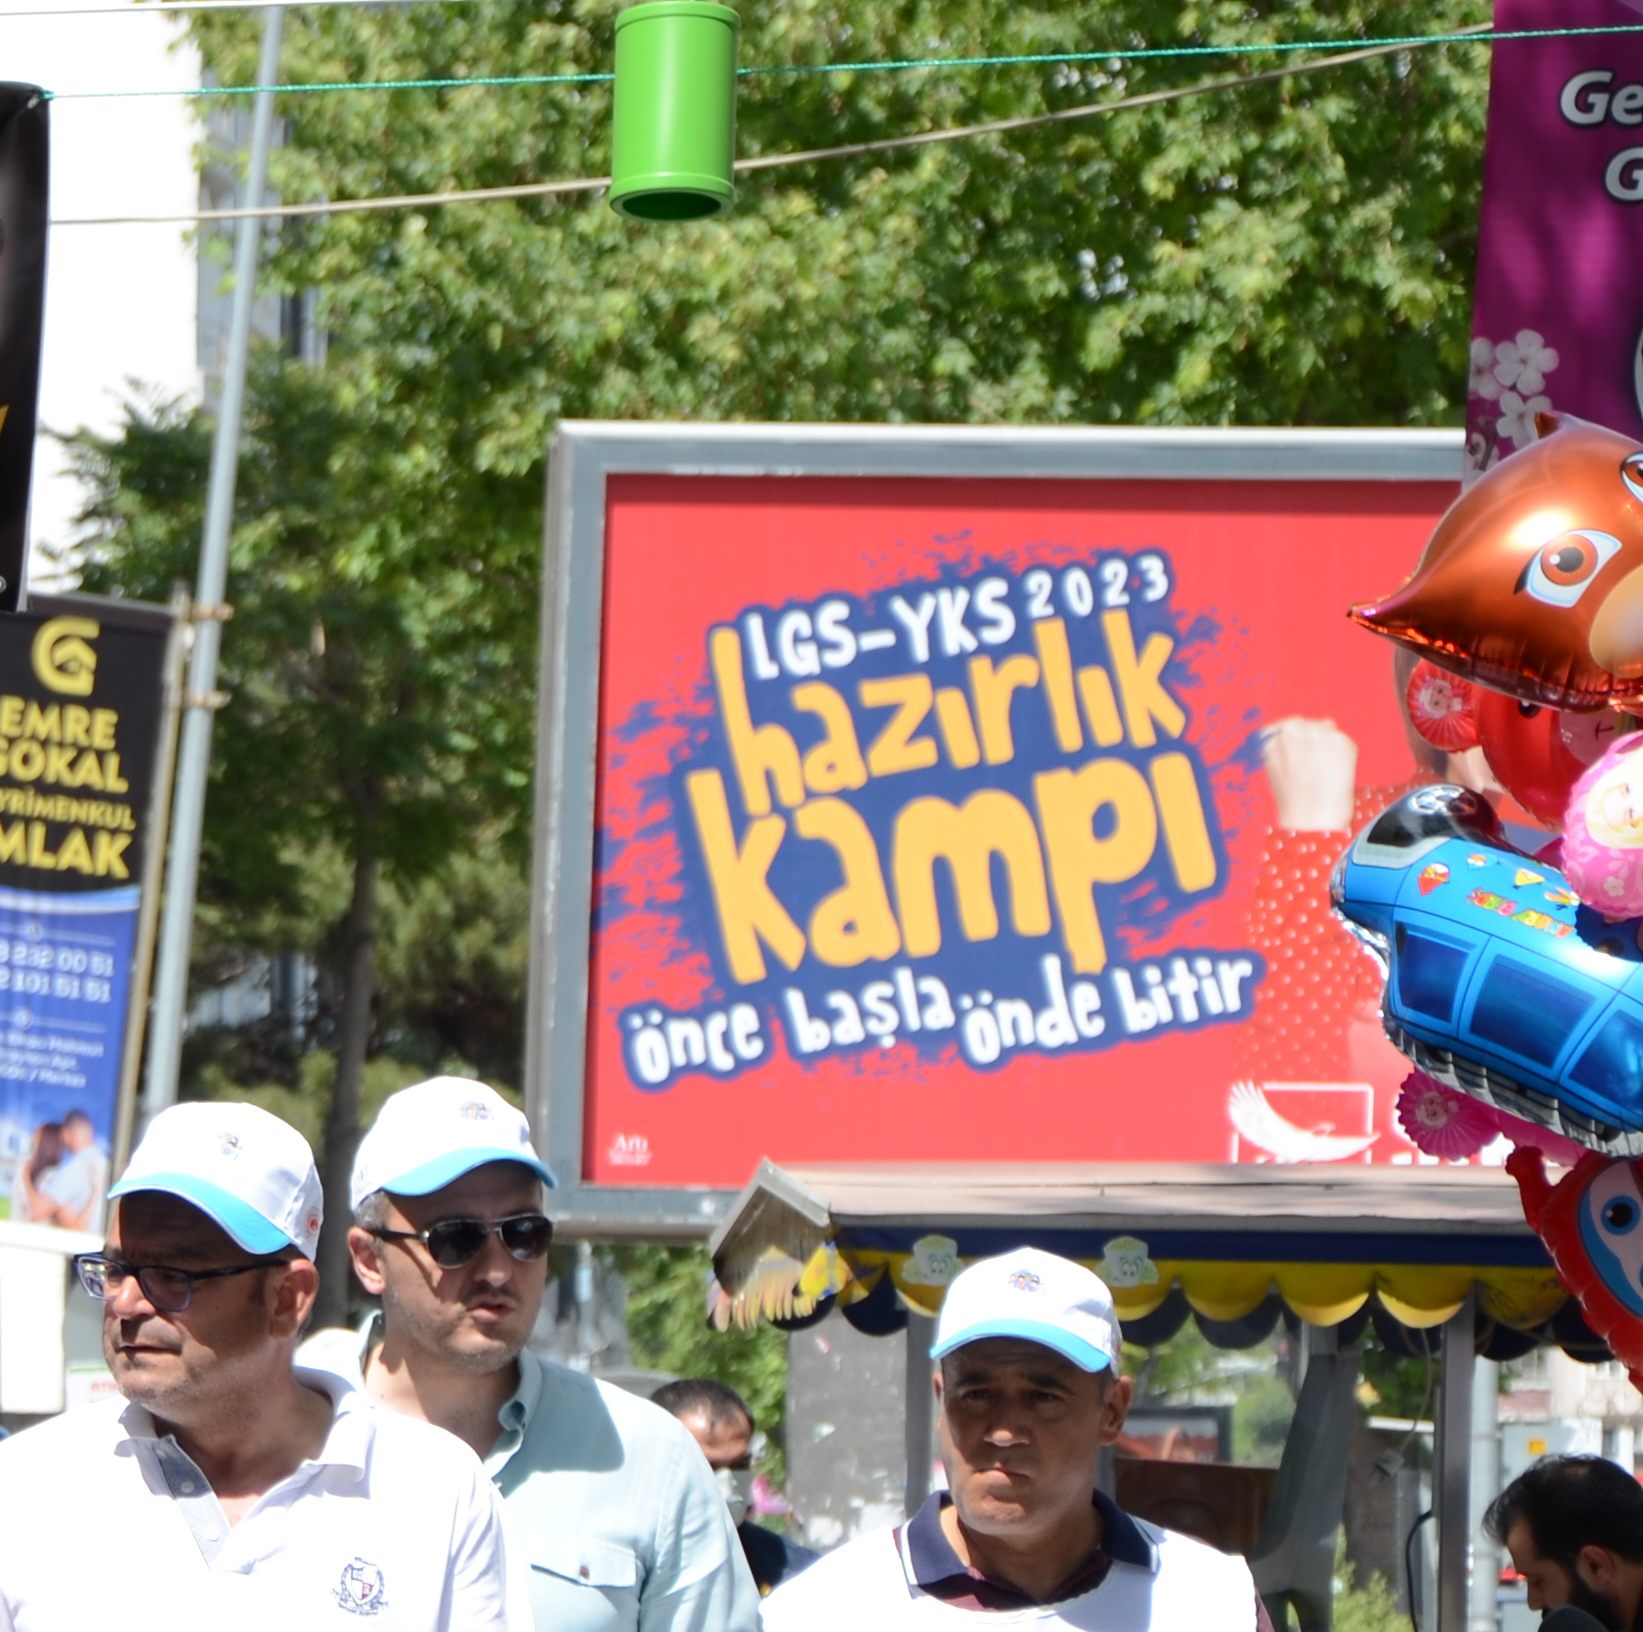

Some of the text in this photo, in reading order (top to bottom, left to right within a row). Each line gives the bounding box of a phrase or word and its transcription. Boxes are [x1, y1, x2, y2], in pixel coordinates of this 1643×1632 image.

[739, 554, 1170, 682] LGS-YKS 2023
[715, 608, 1188, 815] hazırlık
[685, 751, 1218, 986] kampı
[11, 967, 51, 996] 101
[12, 941, 55, 970] 232
[57, 946, 89, 974] 00
[628, 953, 1253, 1084] önce başla önde bitir
